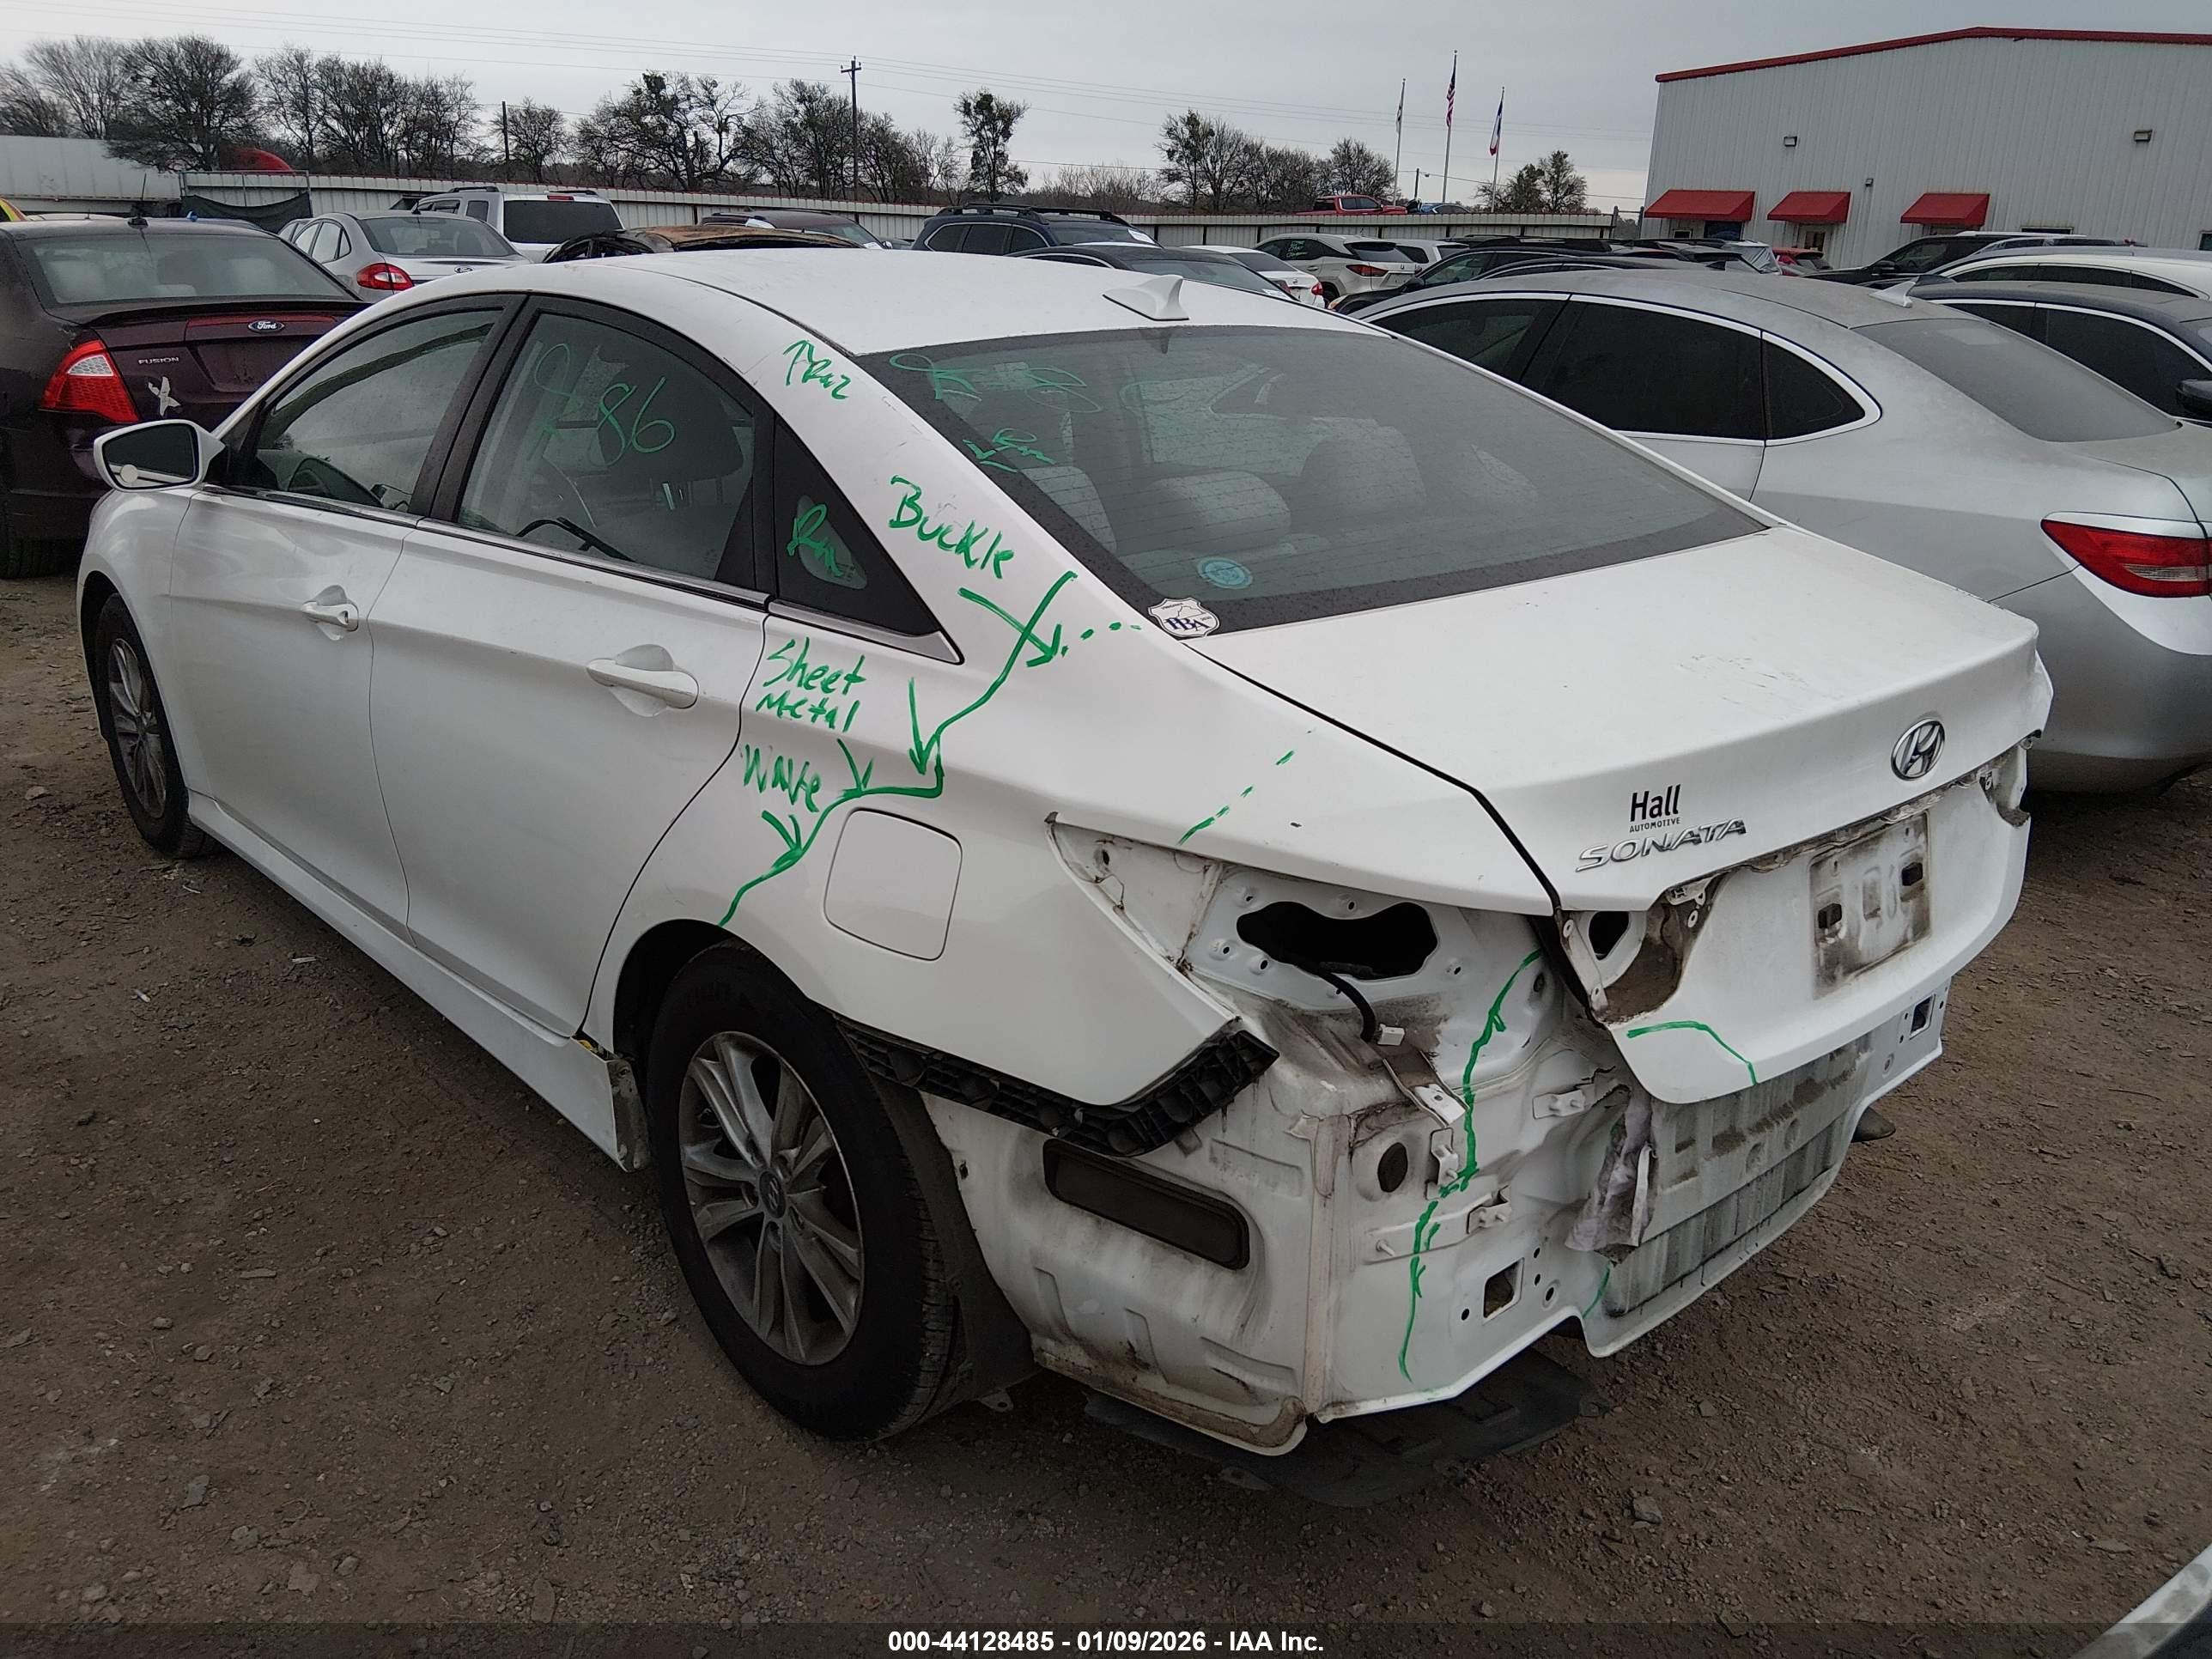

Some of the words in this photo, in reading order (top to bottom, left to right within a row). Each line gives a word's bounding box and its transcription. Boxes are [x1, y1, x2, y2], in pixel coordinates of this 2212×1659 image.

[137, 356, 179, 365] FUSION
[763, 636, 866, 696] Sheet
[1630, 784, 1681, 822] Hall
[1629, 817, 1681, 833] AUTOMOTIVE
[1576, 817, 1747, 872] SONATA
